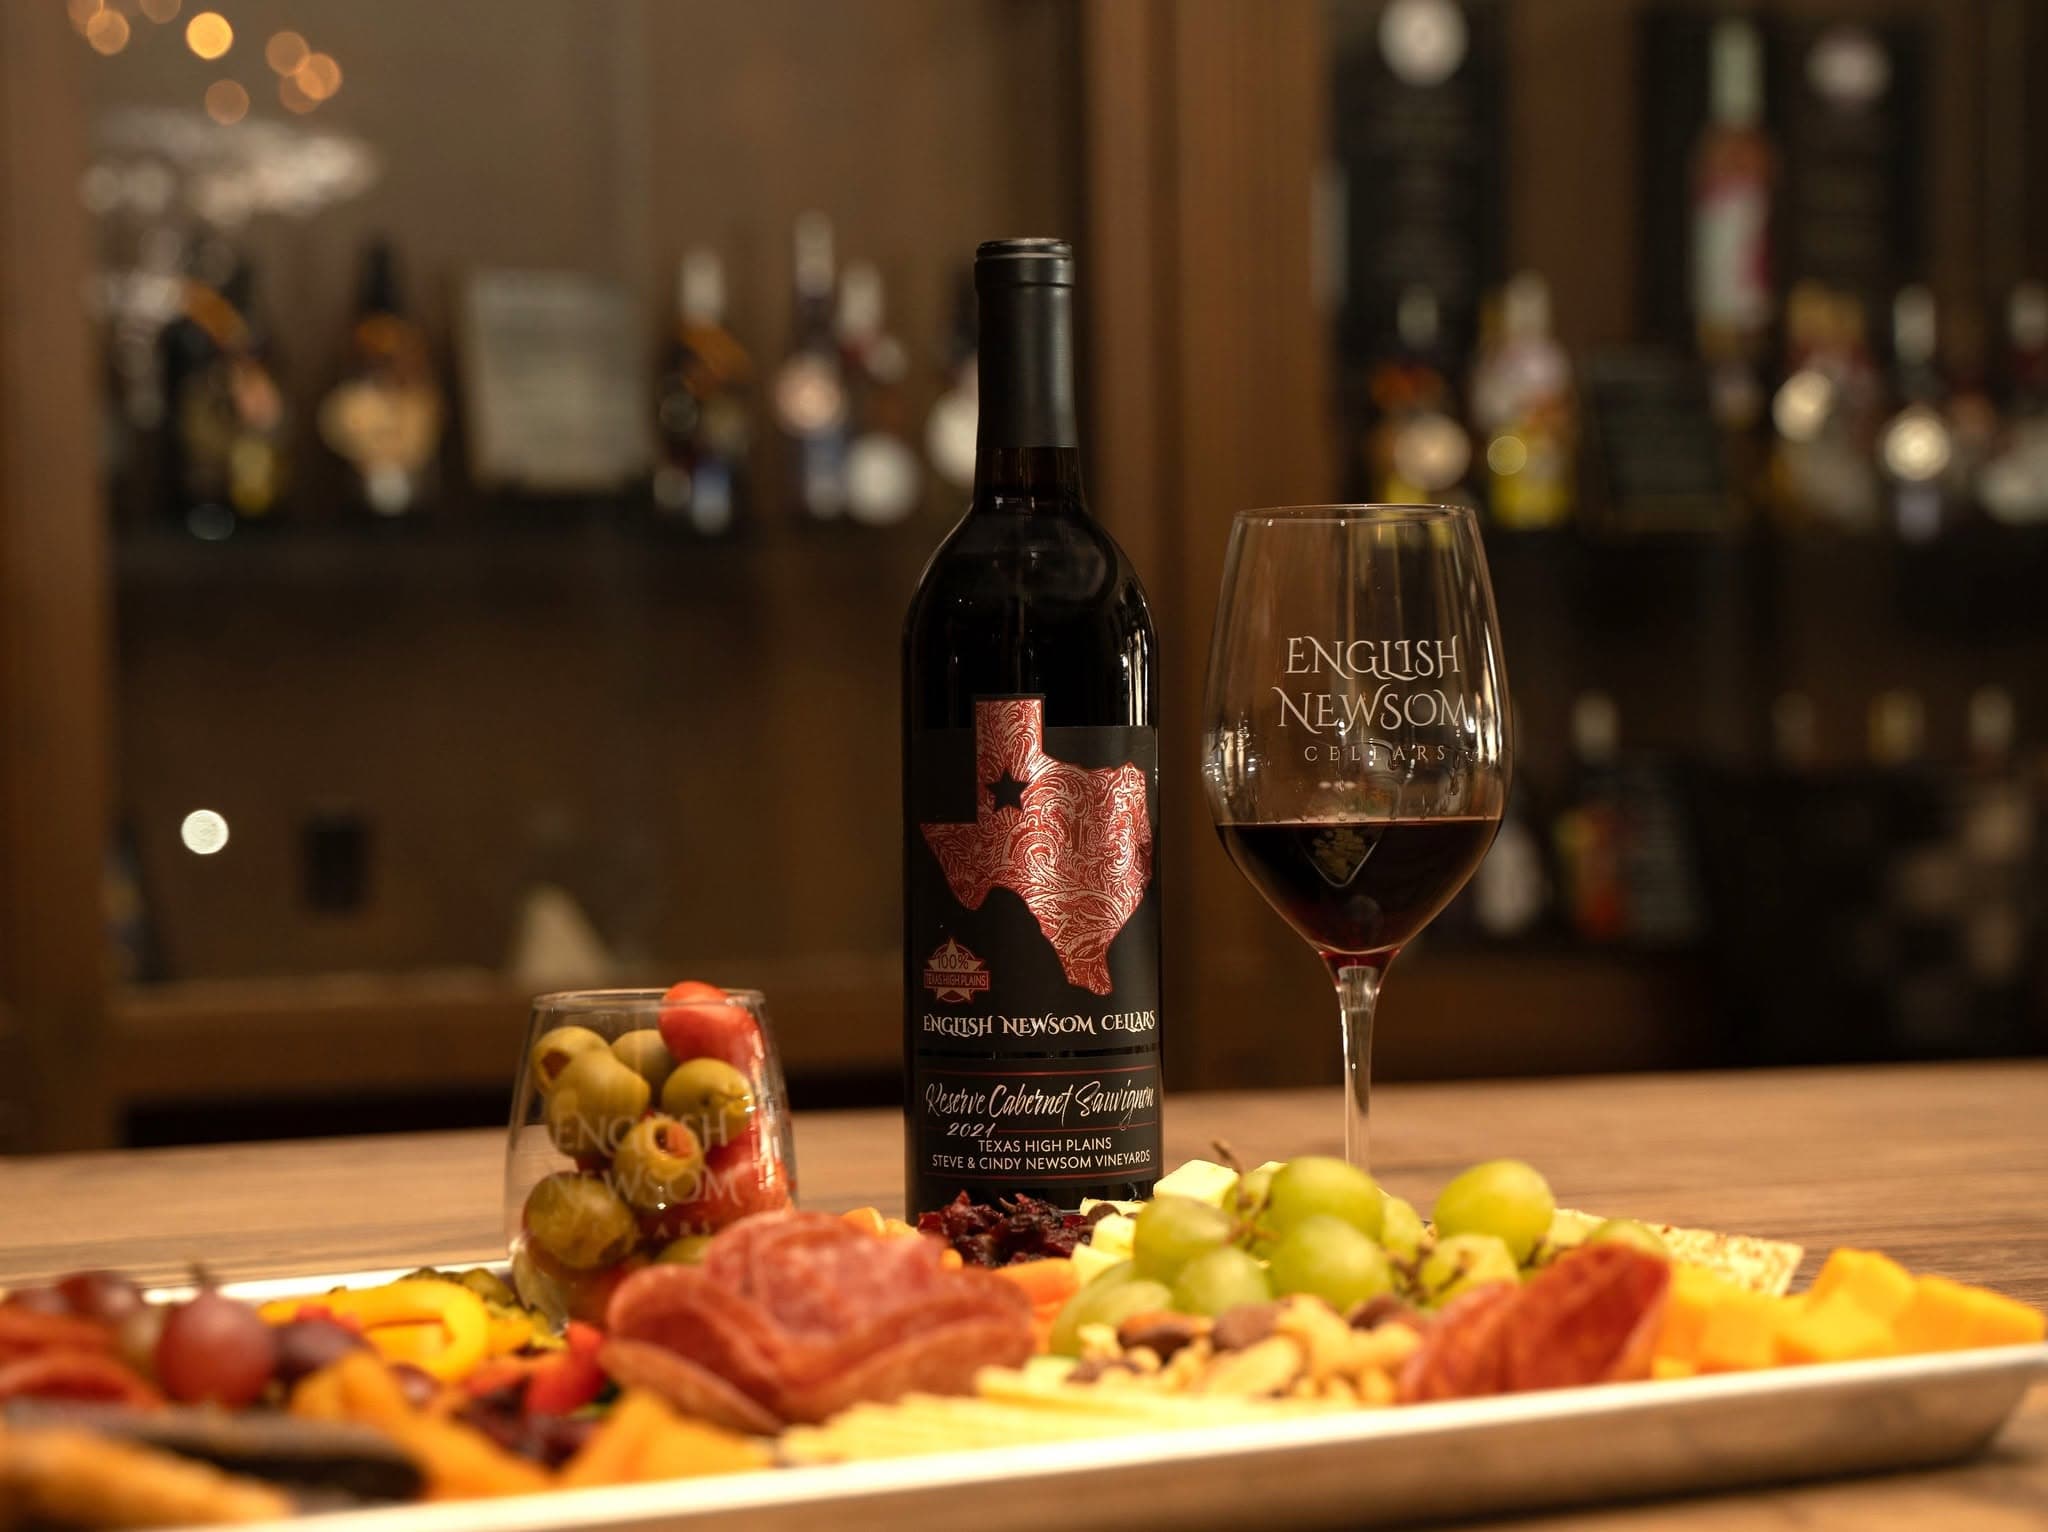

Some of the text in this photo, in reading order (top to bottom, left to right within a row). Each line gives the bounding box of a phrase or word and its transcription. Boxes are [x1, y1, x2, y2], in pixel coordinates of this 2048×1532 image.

[1285, 635, 1461, 681] ENGLISH
[1272, 683, 1475, 736] NEWSOM
[1304, 745, 1446, 761] CELLARS
[935, 952, 969, 970] 100%
[925, 973, 987, 986] TEXAS HIGH PLAINS
[923, 1010, 1156, 1038] ENGLISH NEWSOM CELLARS
[925, 1079, 1155, 1132] Reserve Cabernet Sauvignon
[555, 1108, 729, 1157] ENGSH
[946, 1122, 997, 1138] 2021
[978, 1136, 1112, 1153] TEXAS HIGH PLAINS
[932, 1149, 1150, 1170] STEVE & CINDY NEWSOM VINEYARDS
